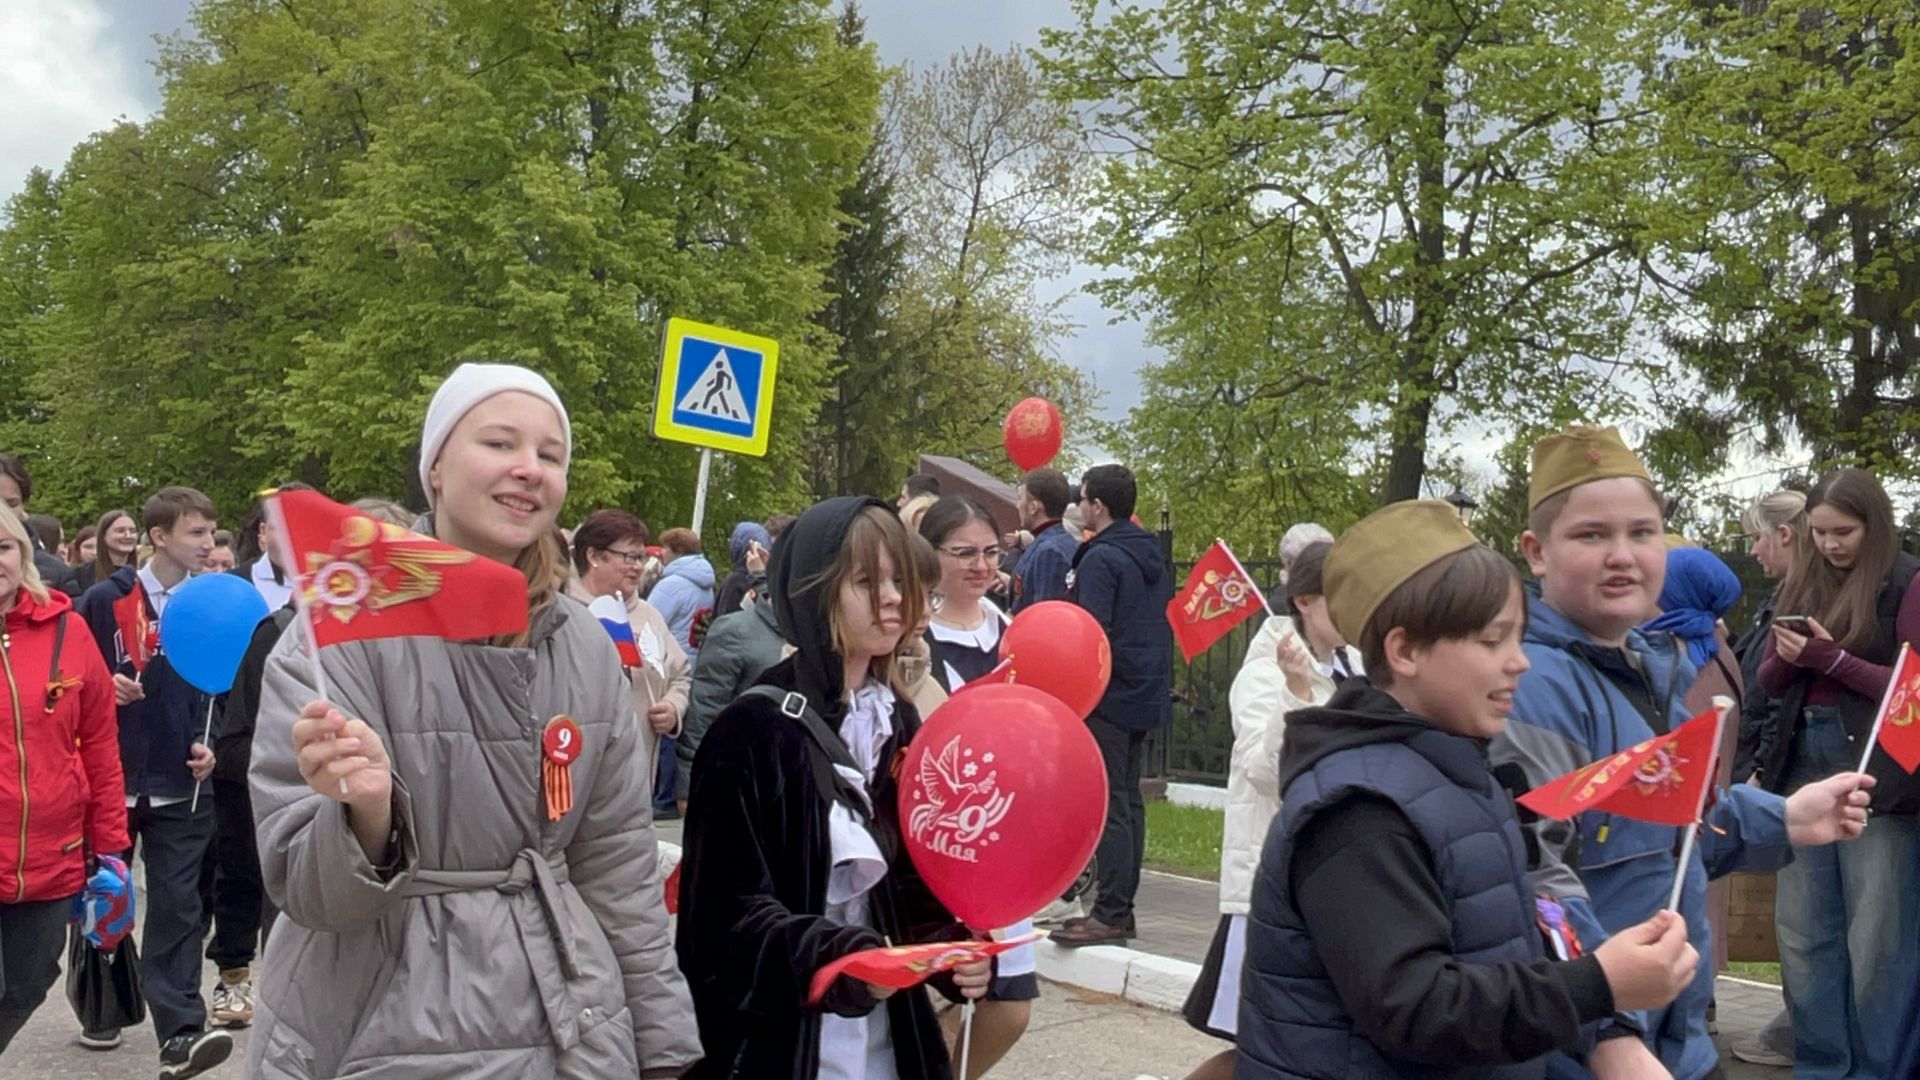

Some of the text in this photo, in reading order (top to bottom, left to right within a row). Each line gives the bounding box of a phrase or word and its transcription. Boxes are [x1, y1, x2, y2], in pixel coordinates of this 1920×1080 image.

[558, 728, 571, 749] 9
[954, 805, 988, 843] 9
[925, 829, 979, 863] Мая
